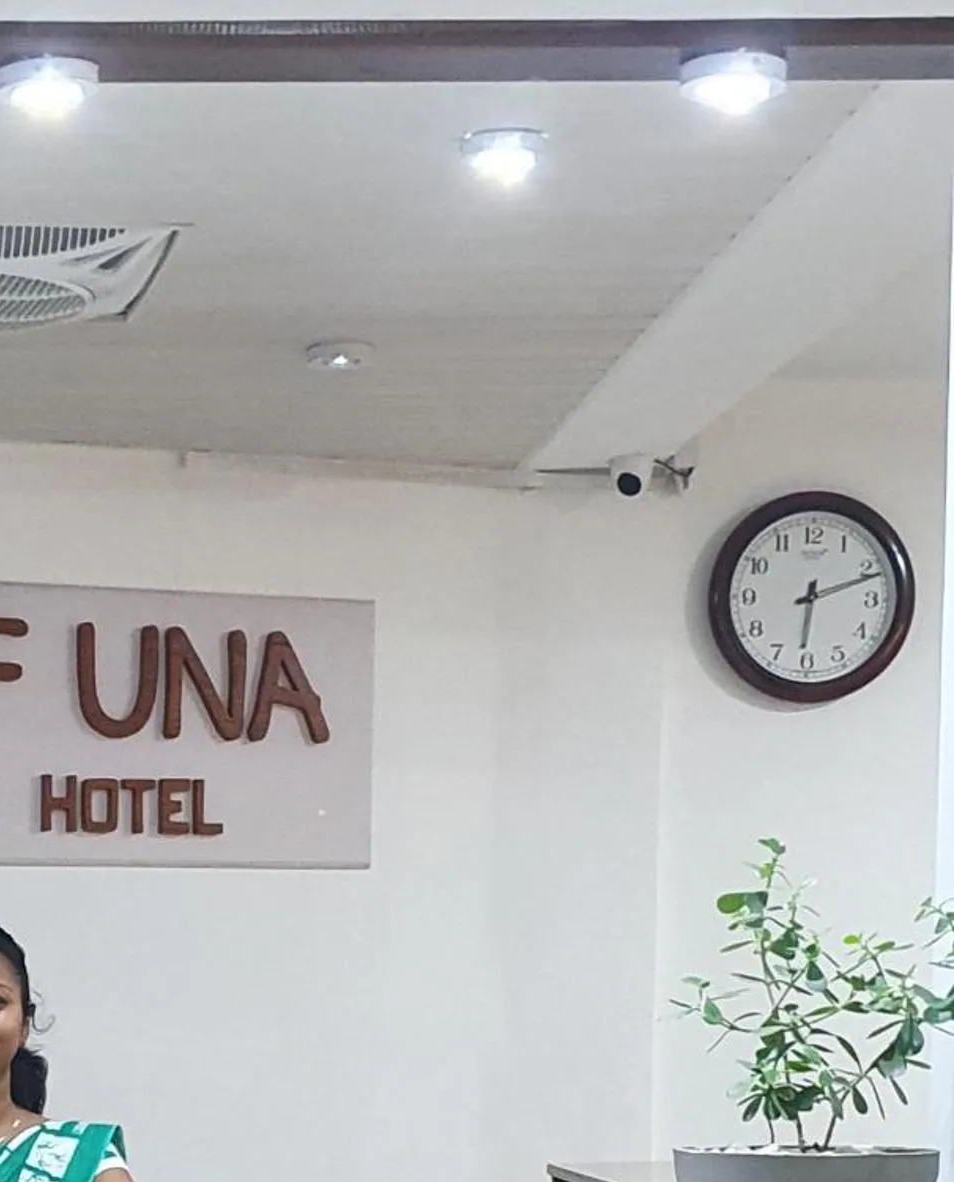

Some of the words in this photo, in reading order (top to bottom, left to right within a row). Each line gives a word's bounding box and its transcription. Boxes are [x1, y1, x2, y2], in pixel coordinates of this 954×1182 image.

[775, 534, 789, 552] 11
[804, 526, 824, 545] 12
[840, 534, 847, 553] 1
[749, 556, 768, 575] 10
[860, 560, 876, 579] 2
[742, 588, 757, 606] 9
[863, 591, 879, 609] 3
[749, 620, 764, 637] 8
[853, 622, 867, 640] 4
[770, 643, 784, 661] 7
[799, 652, 814, 670] 6
[830, 645, 846, 662] 5
[76, 620, 330, 744] UNA
[40, 774, 224, 837] HOTEL
